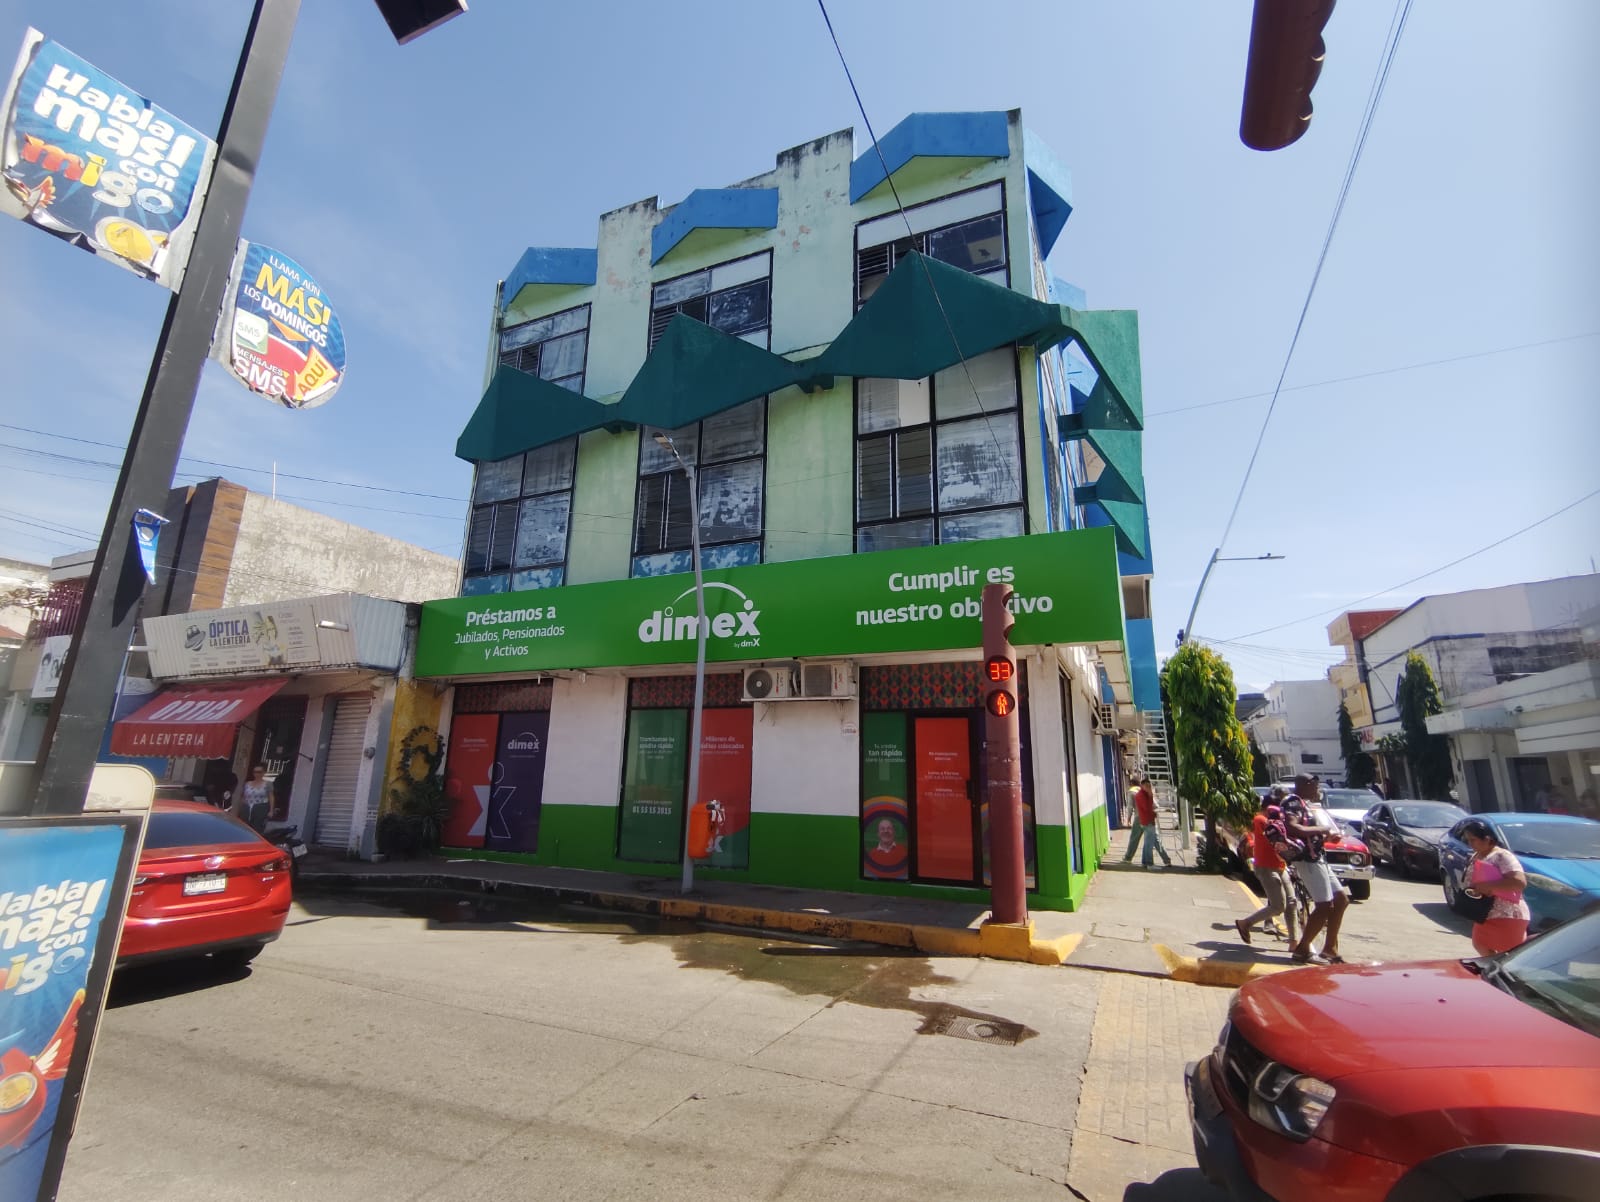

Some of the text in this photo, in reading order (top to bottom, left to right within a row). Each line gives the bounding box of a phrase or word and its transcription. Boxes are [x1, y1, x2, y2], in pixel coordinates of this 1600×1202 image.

[46, 63, 175, 142] Habla
[20, 132, 174, 214] migo
[119, 159, 176, 192] con
[269, 255, 320, 296] LLAMA AÚN
[256, 263, 331, 333] MÁS!
[244, 284, 327, 347] LOS DOMINGOS
[238, 321, 260, 337] SMS
[236, 348, 284, 376] MENSAJES
[234, 357, 287, 396] SMS
[889, 565, 1015, 592] Cumplir es
[466, 606, 556, 626] Préstamos a
[638, 599, 761, 643] dimex
[856, 603, 943, 625] nuestro
[209, 619, 249, 638] ÓPTICA
[454, 624, 565, 644] Jubilados, Pensionados
[210, 638, 217, 647] LA
[485, 644, 529, 660] y Activos
[991, 662, 1010, 680] 33
[147, 694, 243, 720] ÓPTICA
[133, 733, 204, 746] LA LENTERIA
[507, 738, 540, 750] dimex
[38, 930, 87, 954] con
[0, 947, 85, 996] igo
